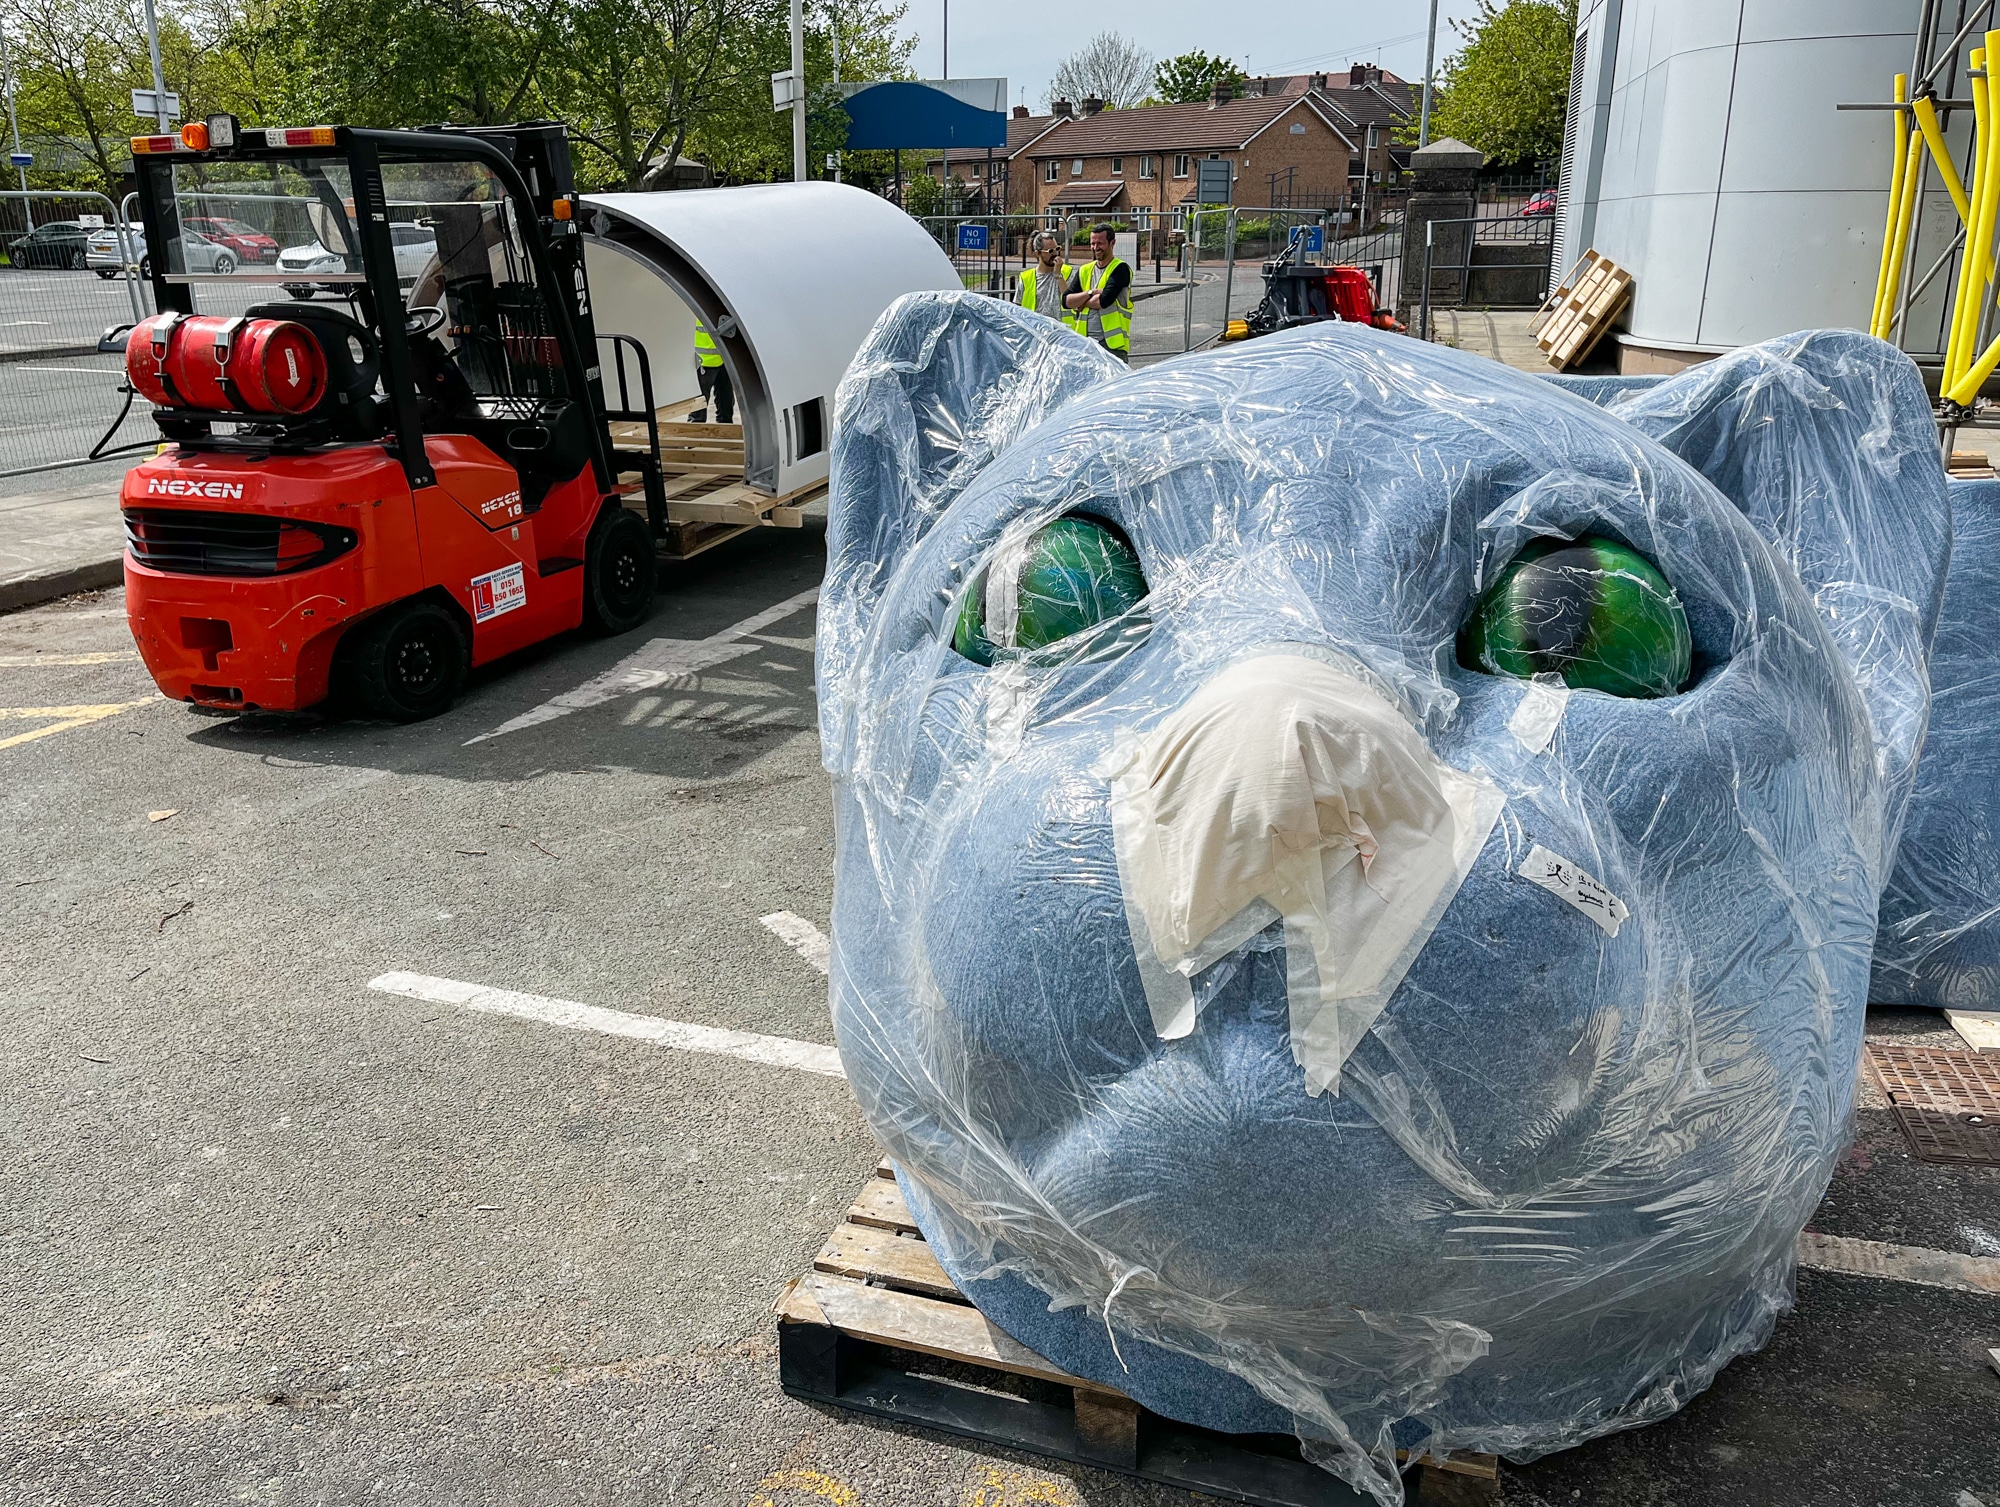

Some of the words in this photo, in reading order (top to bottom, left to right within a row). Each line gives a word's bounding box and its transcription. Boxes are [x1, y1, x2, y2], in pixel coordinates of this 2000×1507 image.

[966, 229, 979, 237] NO
[963, 238, 980, 246] EXIT
[147, 478, 244, 499] NEXEN
[481, 490, 520, 515] NEXEN
[507, 503, 522, 518] 18
[500, 578, 515, 590] 0151
[494, 591, 507, 602] 650
